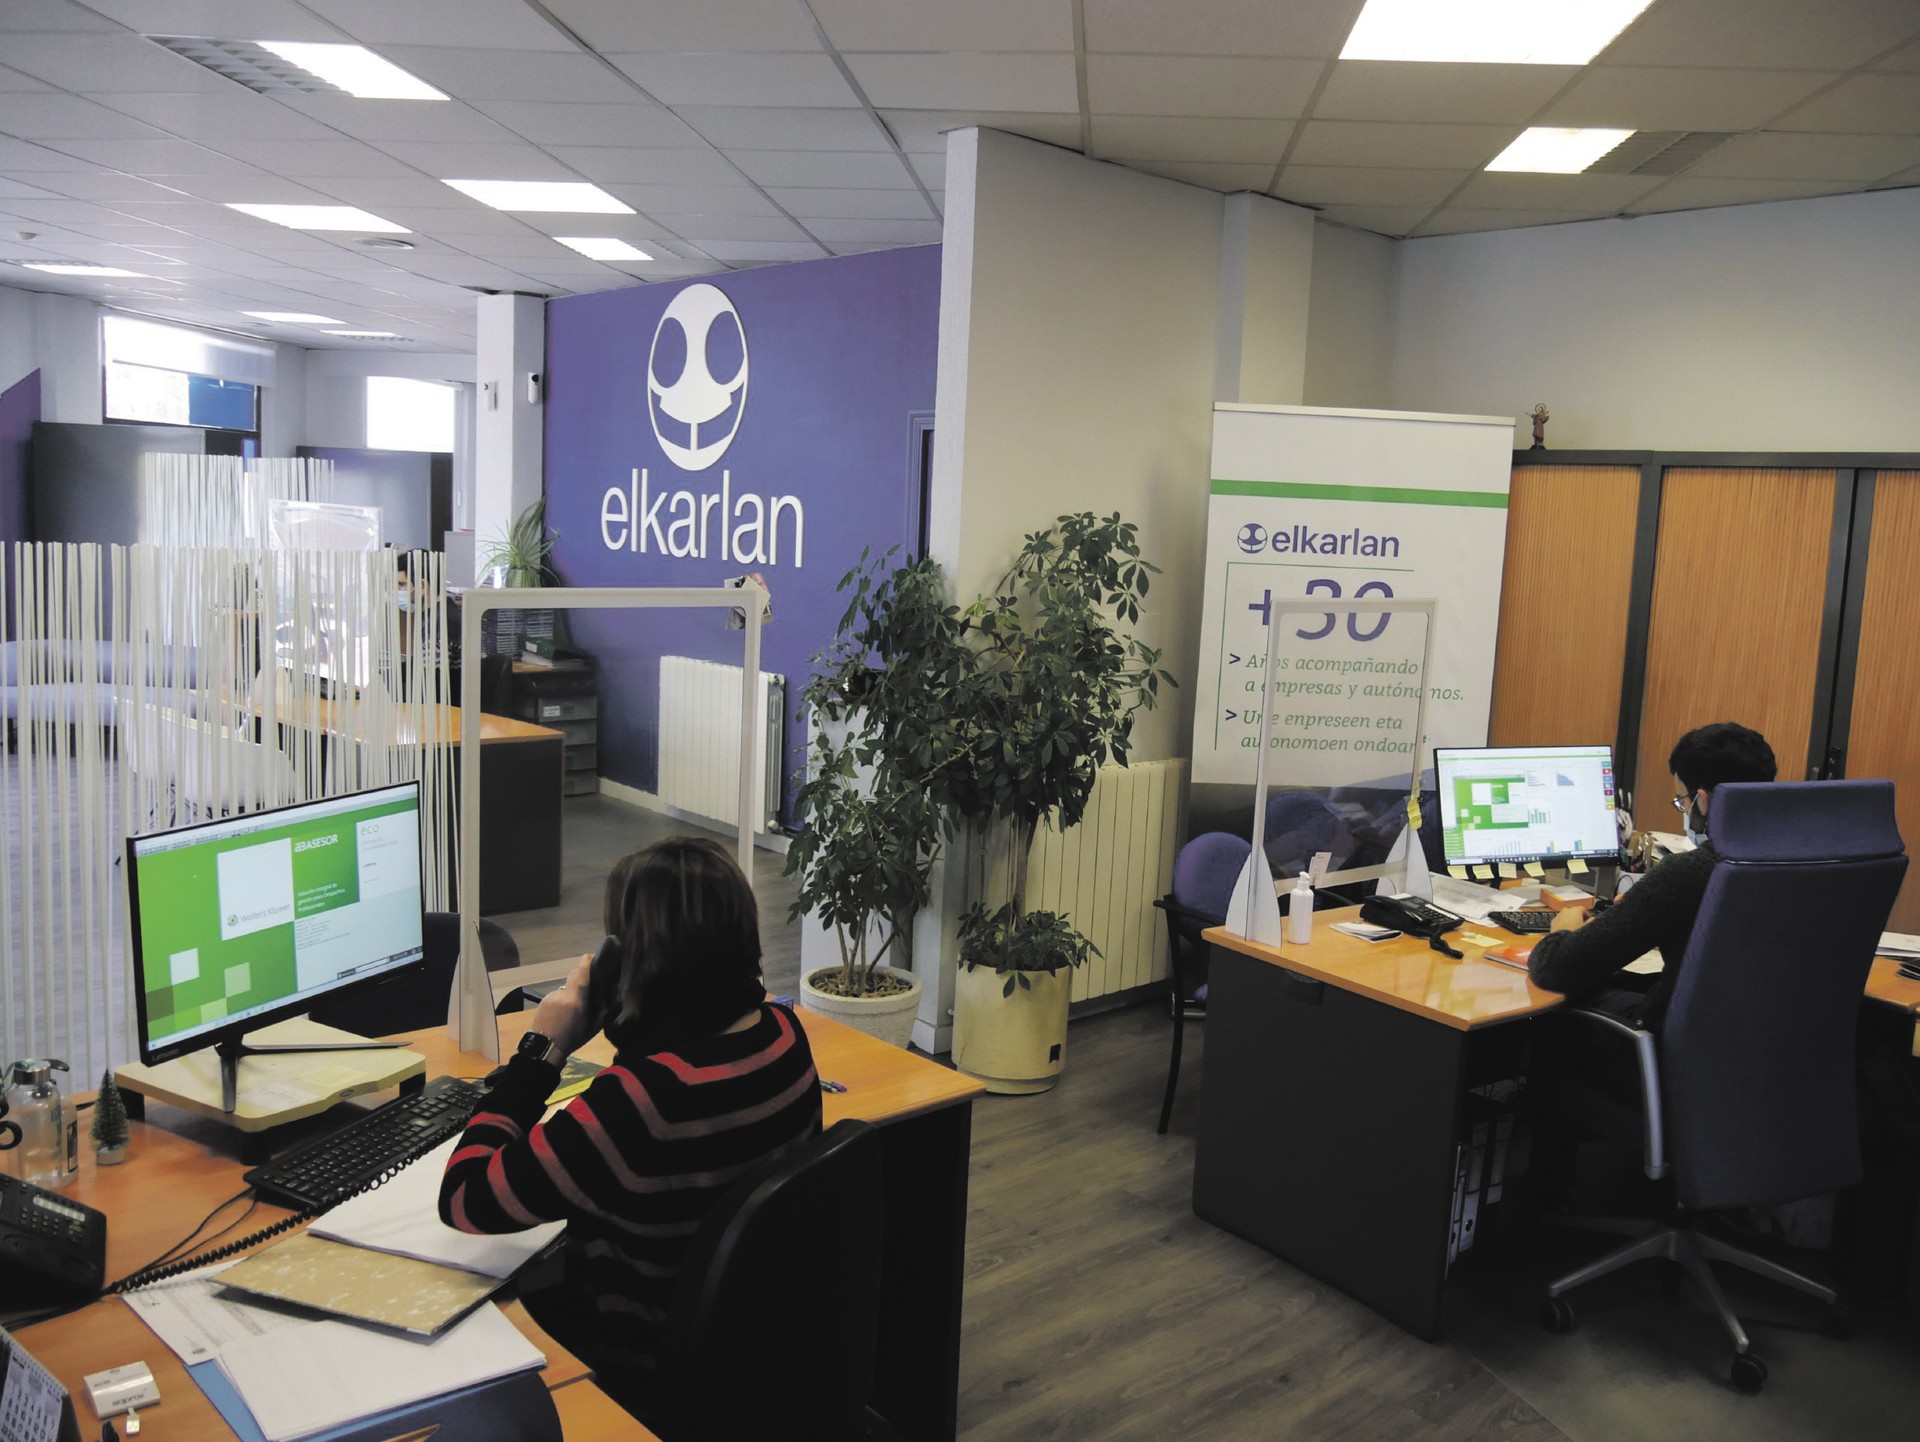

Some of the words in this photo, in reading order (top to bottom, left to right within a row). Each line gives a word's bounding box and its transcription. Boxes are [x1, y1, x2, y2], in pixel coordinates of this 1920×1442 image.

[601, 468, 803, 568] elkarlan
[1271, 525, 1400, 558] elkarlan
[1295, 657, 1419, 676] acompañando
[1244, 680, 1256, 692] a
[1348, 684, 1359, 700] y
[1243, 710, 1280, 725] Ure
[1284, 713, 1370, 730] enpreseen
[1376, 716, 1403, 729] eta
[1240, 736, 1348, 751] auonomoen
[361, 824, 380, 836] eco
[241, 909, 267, 923] Wolters
[268, 903, 291, 915] Kluwer
[152, 1048, 180, 1062] Lenovo
